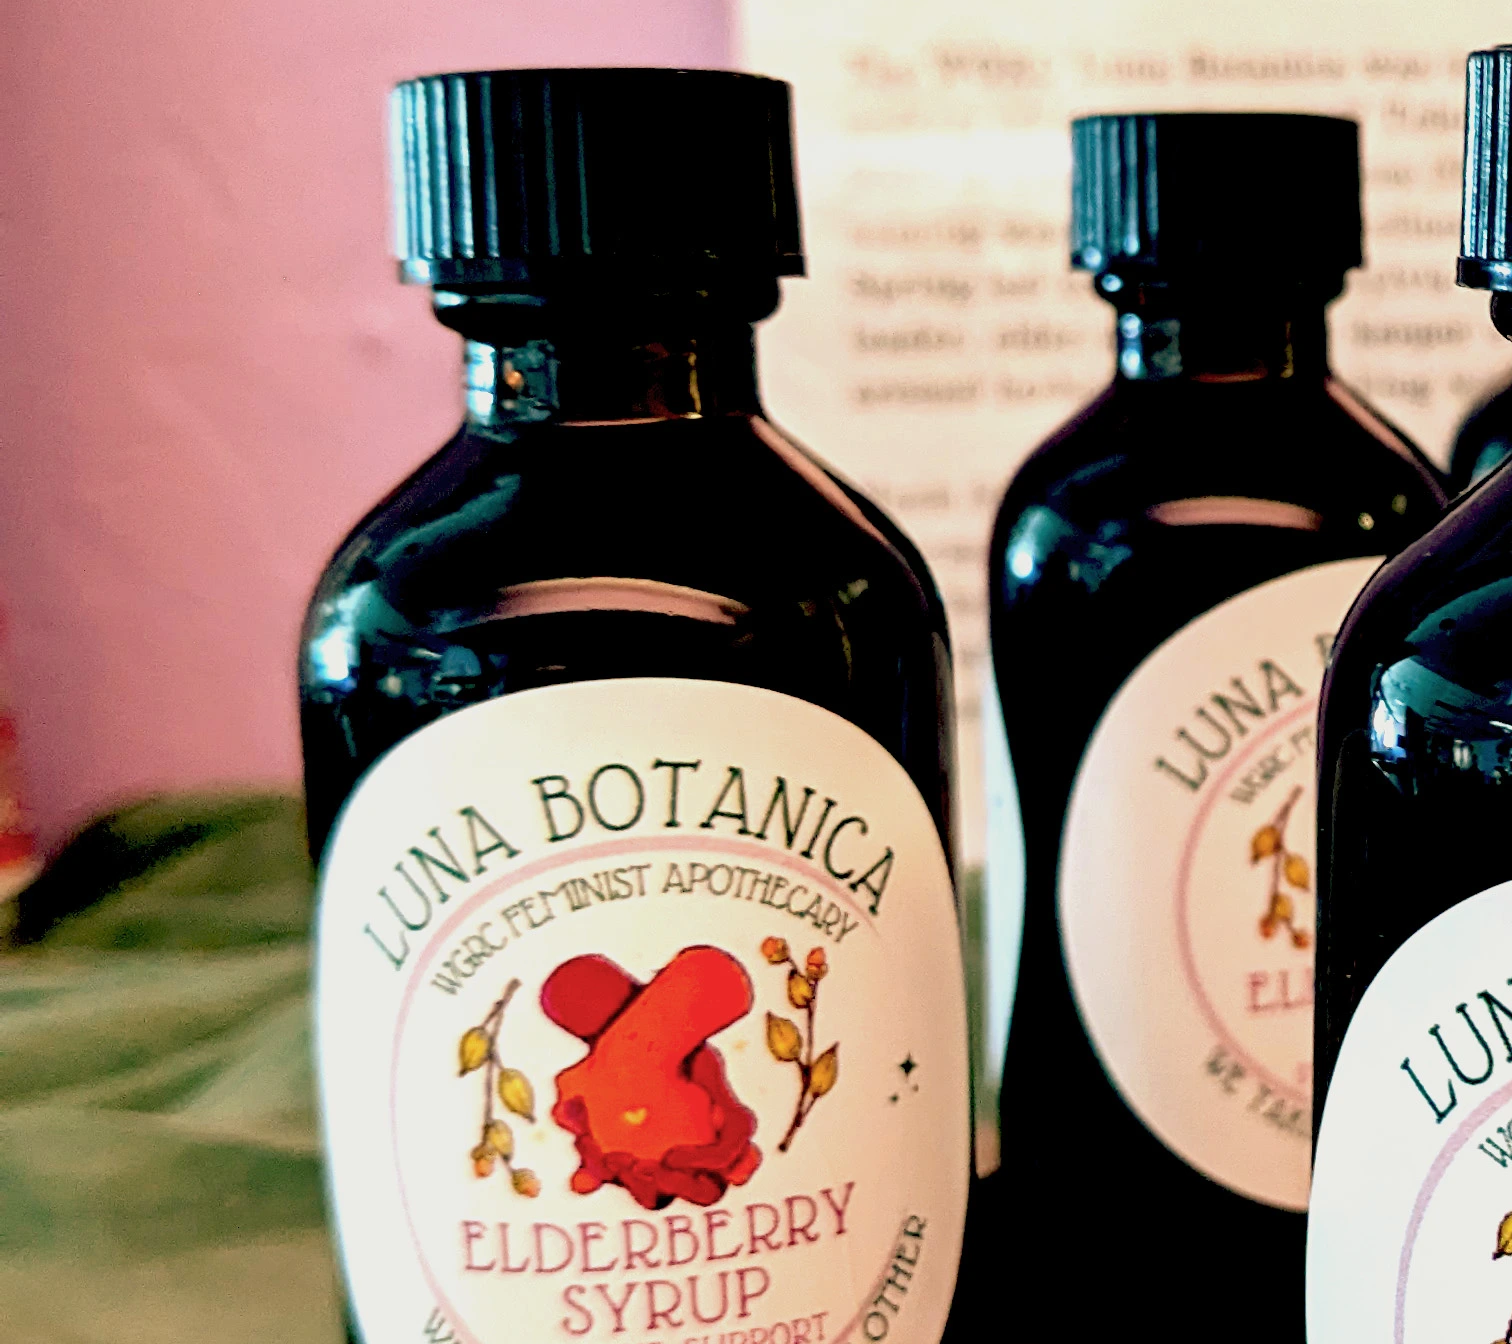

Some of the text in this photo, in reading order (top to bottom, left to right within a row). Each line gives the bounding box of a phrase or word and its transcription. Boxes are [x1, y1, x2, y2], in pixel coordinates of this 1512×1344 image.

[1154, 657, 1304, 794] LUNA
[363, 758, 897, 971] LUNA BOTANICA
[429, 861, 860, 998] WGRC FEMINIST APOTHECARY
[460, 1180, 857, 1275] ELDERBERRY
[862, 1213, 929, 1344] OTHER
[559, 1264, 772, 1338] SYRUP
